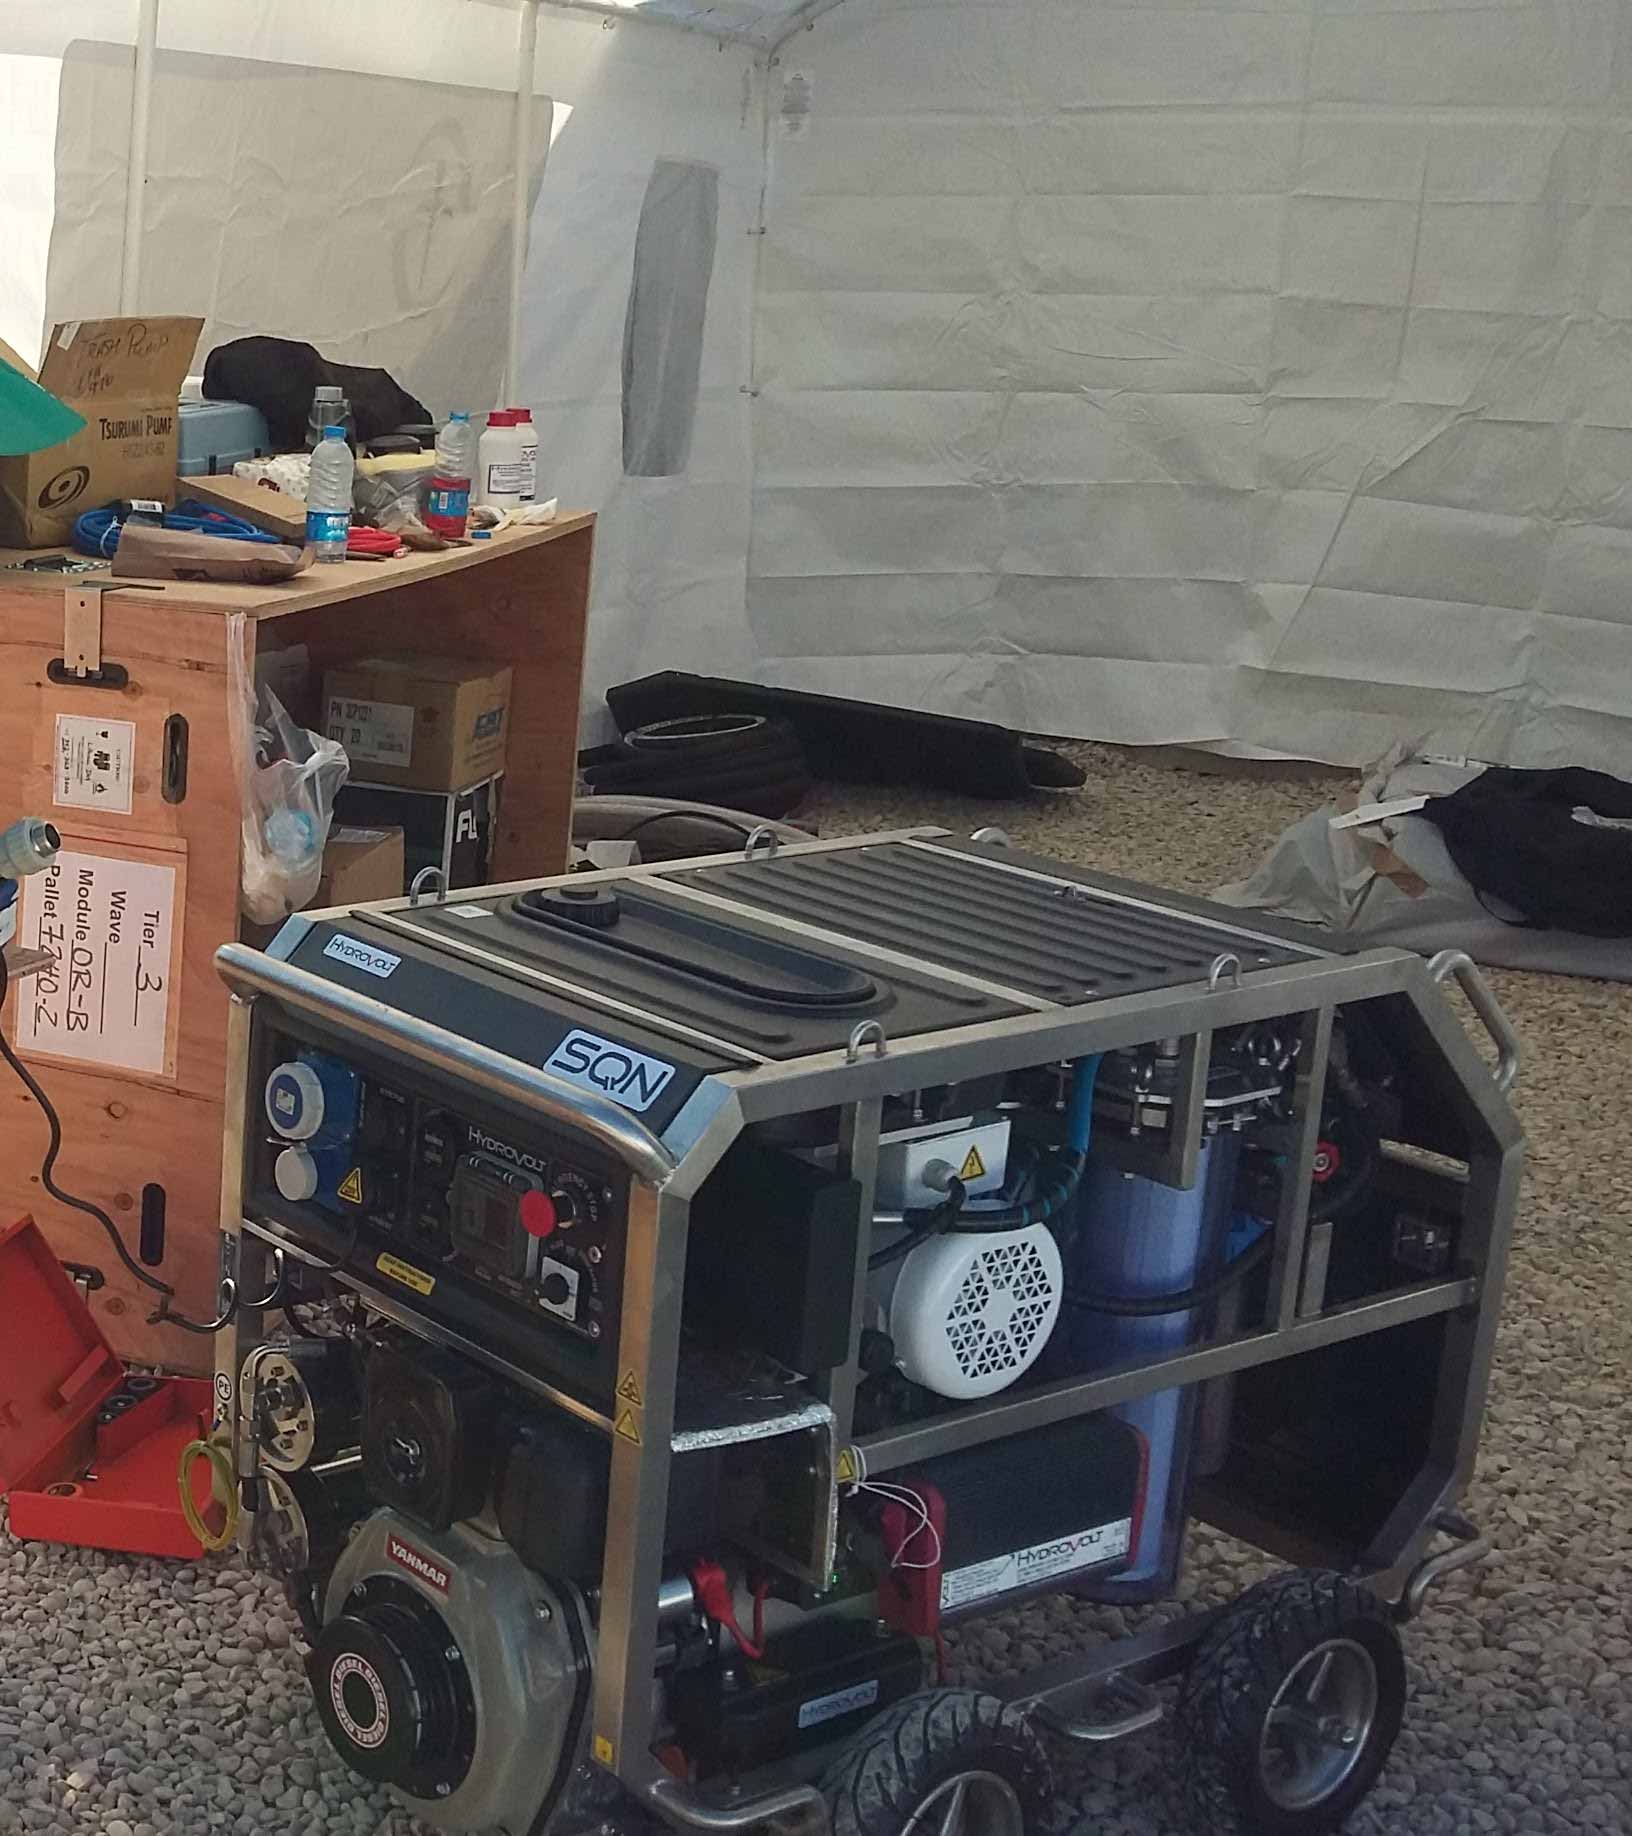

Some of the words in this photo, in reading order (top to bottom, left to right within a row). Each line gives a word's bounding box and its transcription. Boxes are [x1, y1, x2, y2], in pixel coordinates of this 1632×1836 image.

[99, 418, 144, 440] TSURUMI
[43, 865, 61, 919] Pallet
[75, 869, 94, 941] Module
[109, 891, 126, 944] Wave
[143, 911, 159, 948] Tier
[136, 963, 162, 992] 3
[551, 1037, 669, 1104] SQN
[218, 1380, 231, 1394] PE
[391, 1540, 447, 1586] YANMAR
